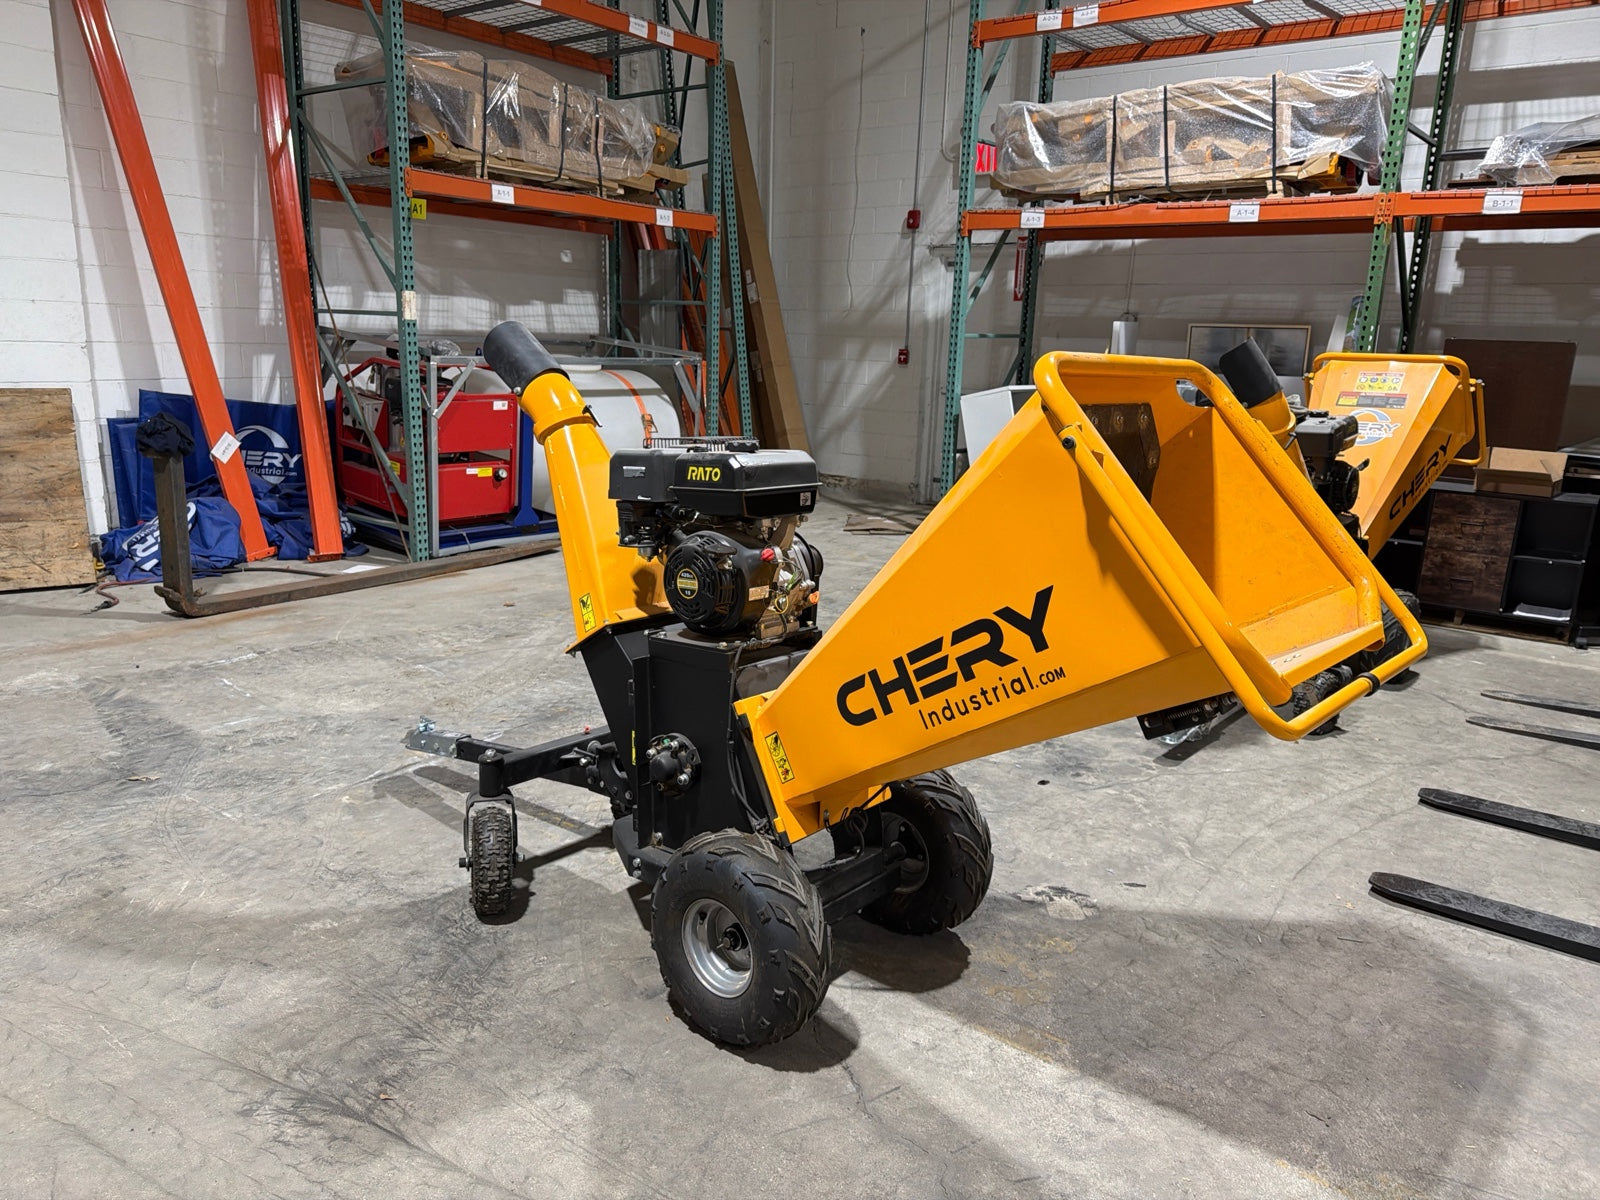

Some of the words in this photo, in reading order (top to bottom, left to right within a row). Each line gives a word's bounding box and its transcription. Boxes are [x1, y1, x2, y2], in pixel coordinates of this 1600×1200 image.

[412, 203, 423, 215] A1
[1492, 199, 1514, 208] B-1-1
[240, 449, 302, 468] ERY
[687, 466, 721, 482] RATO
[1389, 433, 1453, 520] CHERY
[836, 584, 1054, 727] CHERY
